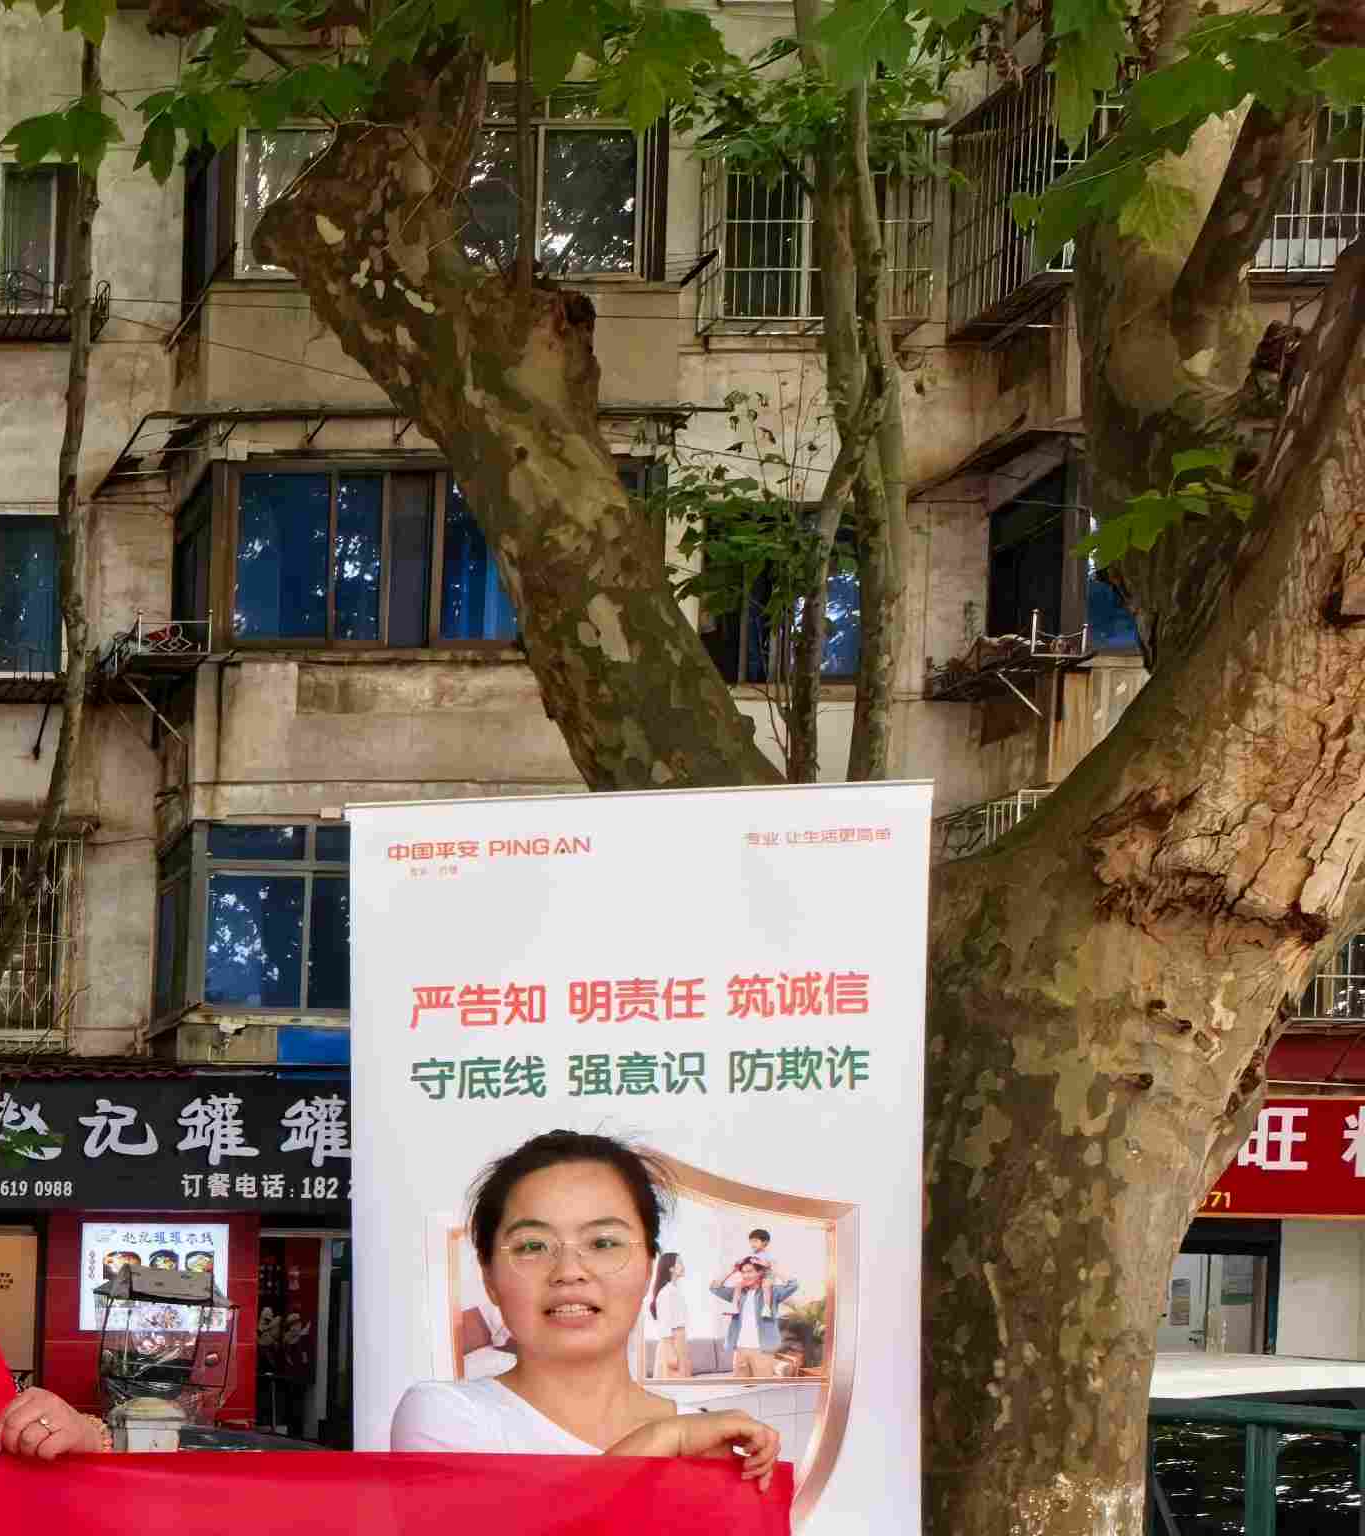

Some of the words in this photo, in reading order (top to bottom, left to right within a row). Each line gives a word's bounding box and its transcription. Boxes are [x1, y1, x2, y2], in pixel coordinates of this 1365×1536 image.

[387, 842, 480, 862] 中国平安
[409, 983, 547, 1031] 严告知
[568, 978, 706, 1024] 明责任
[726, 971, 871, 1020] 筑诚信
[410, 1055, 547, 1101] 守底线
[568, 1050, 707, 1098] 强意识
[728, 1044, 871, 1094] 防欺诈
[34, 1180, 73, 1197] 0988
